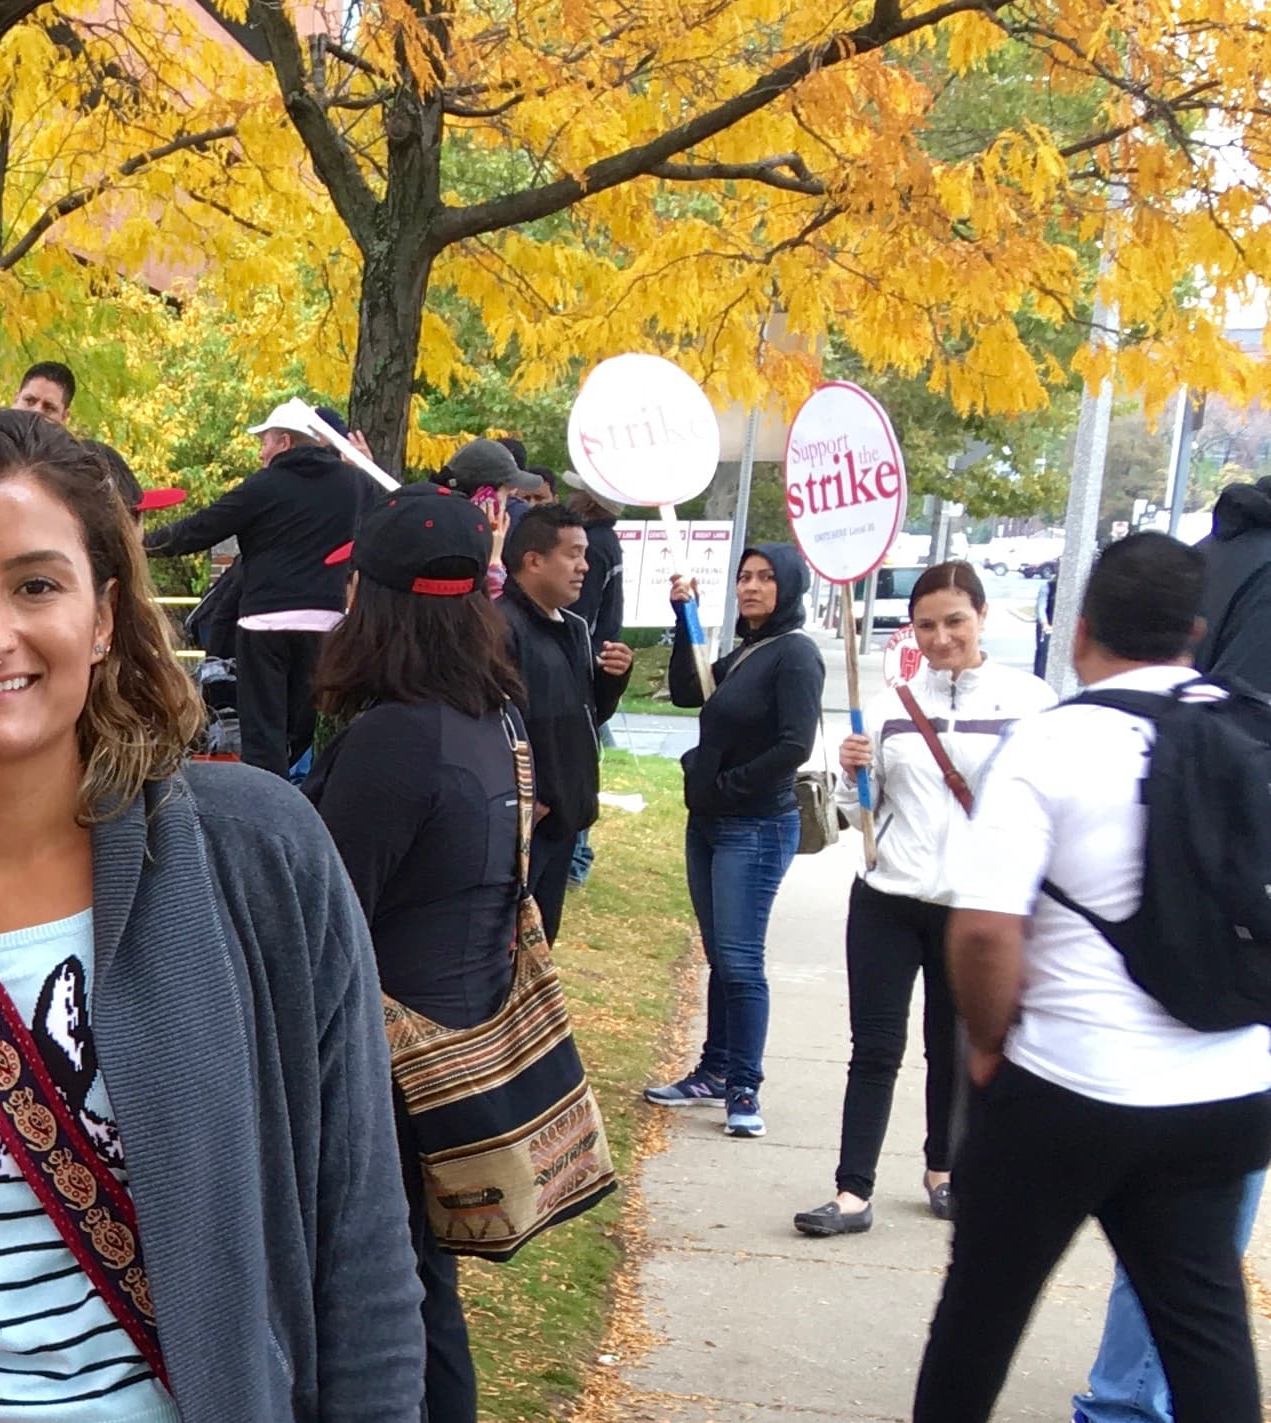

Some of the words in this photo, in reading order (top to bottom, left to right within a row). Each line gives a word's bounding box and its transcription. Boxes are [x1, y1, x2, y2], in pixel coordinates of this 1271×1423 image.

[791, 432, 850, 468] Support
[859, 445, 880, 464] the
[787, 450, 899, 519] strike
